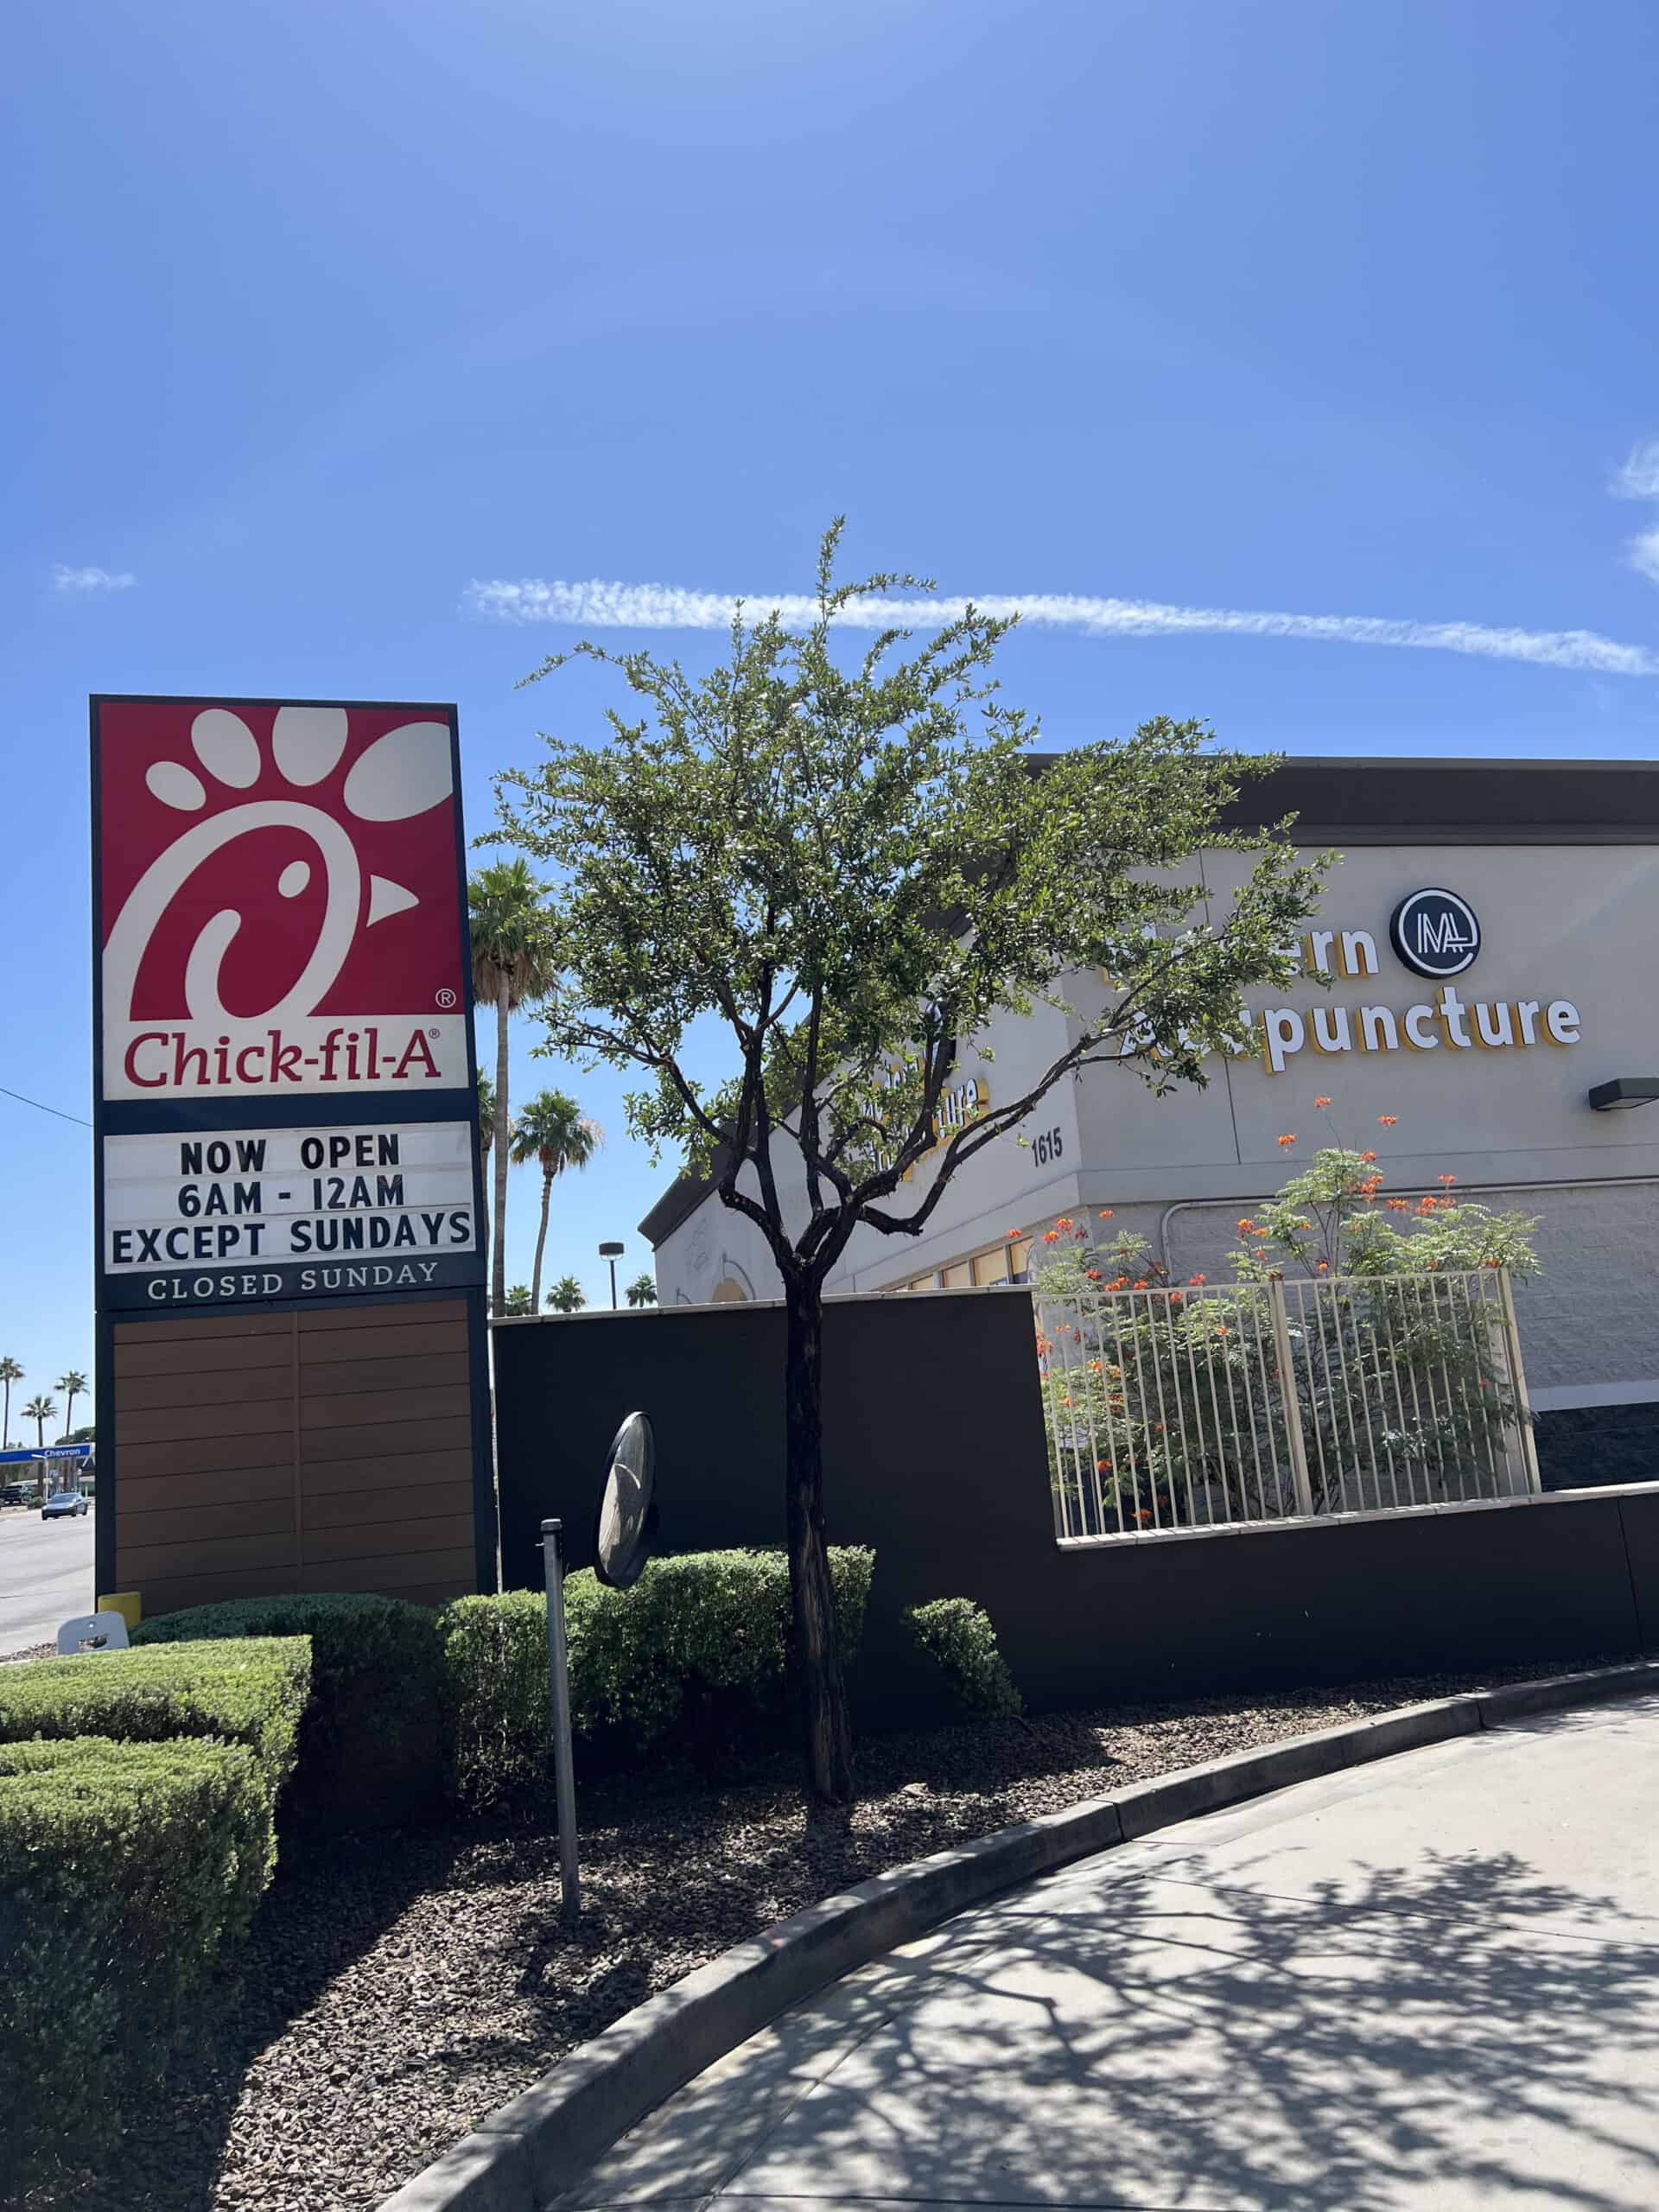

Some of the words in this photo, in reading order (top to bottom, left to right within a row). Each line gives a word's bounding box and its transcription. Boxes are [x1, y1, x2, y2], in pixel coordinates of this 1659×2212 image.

[181, 1139, 267, 1175] NOW
[301, 1134, 400, 1169] OPEN
[1031, 1127, 1064, 1168] 1615
[178, 1181, 263, 1217] 6AM
[313, 1174, 404, 1211] 12AM
[112, 1224, 265, 1264] EXCEPT
[290, 1211, 470, 1253] SUNDAYS
[148, 1274, 283, 1300] CLOSED
[301, 1262, 439, 1289] SUNDAY
[44, 1448, 80, 1457] Chevron
